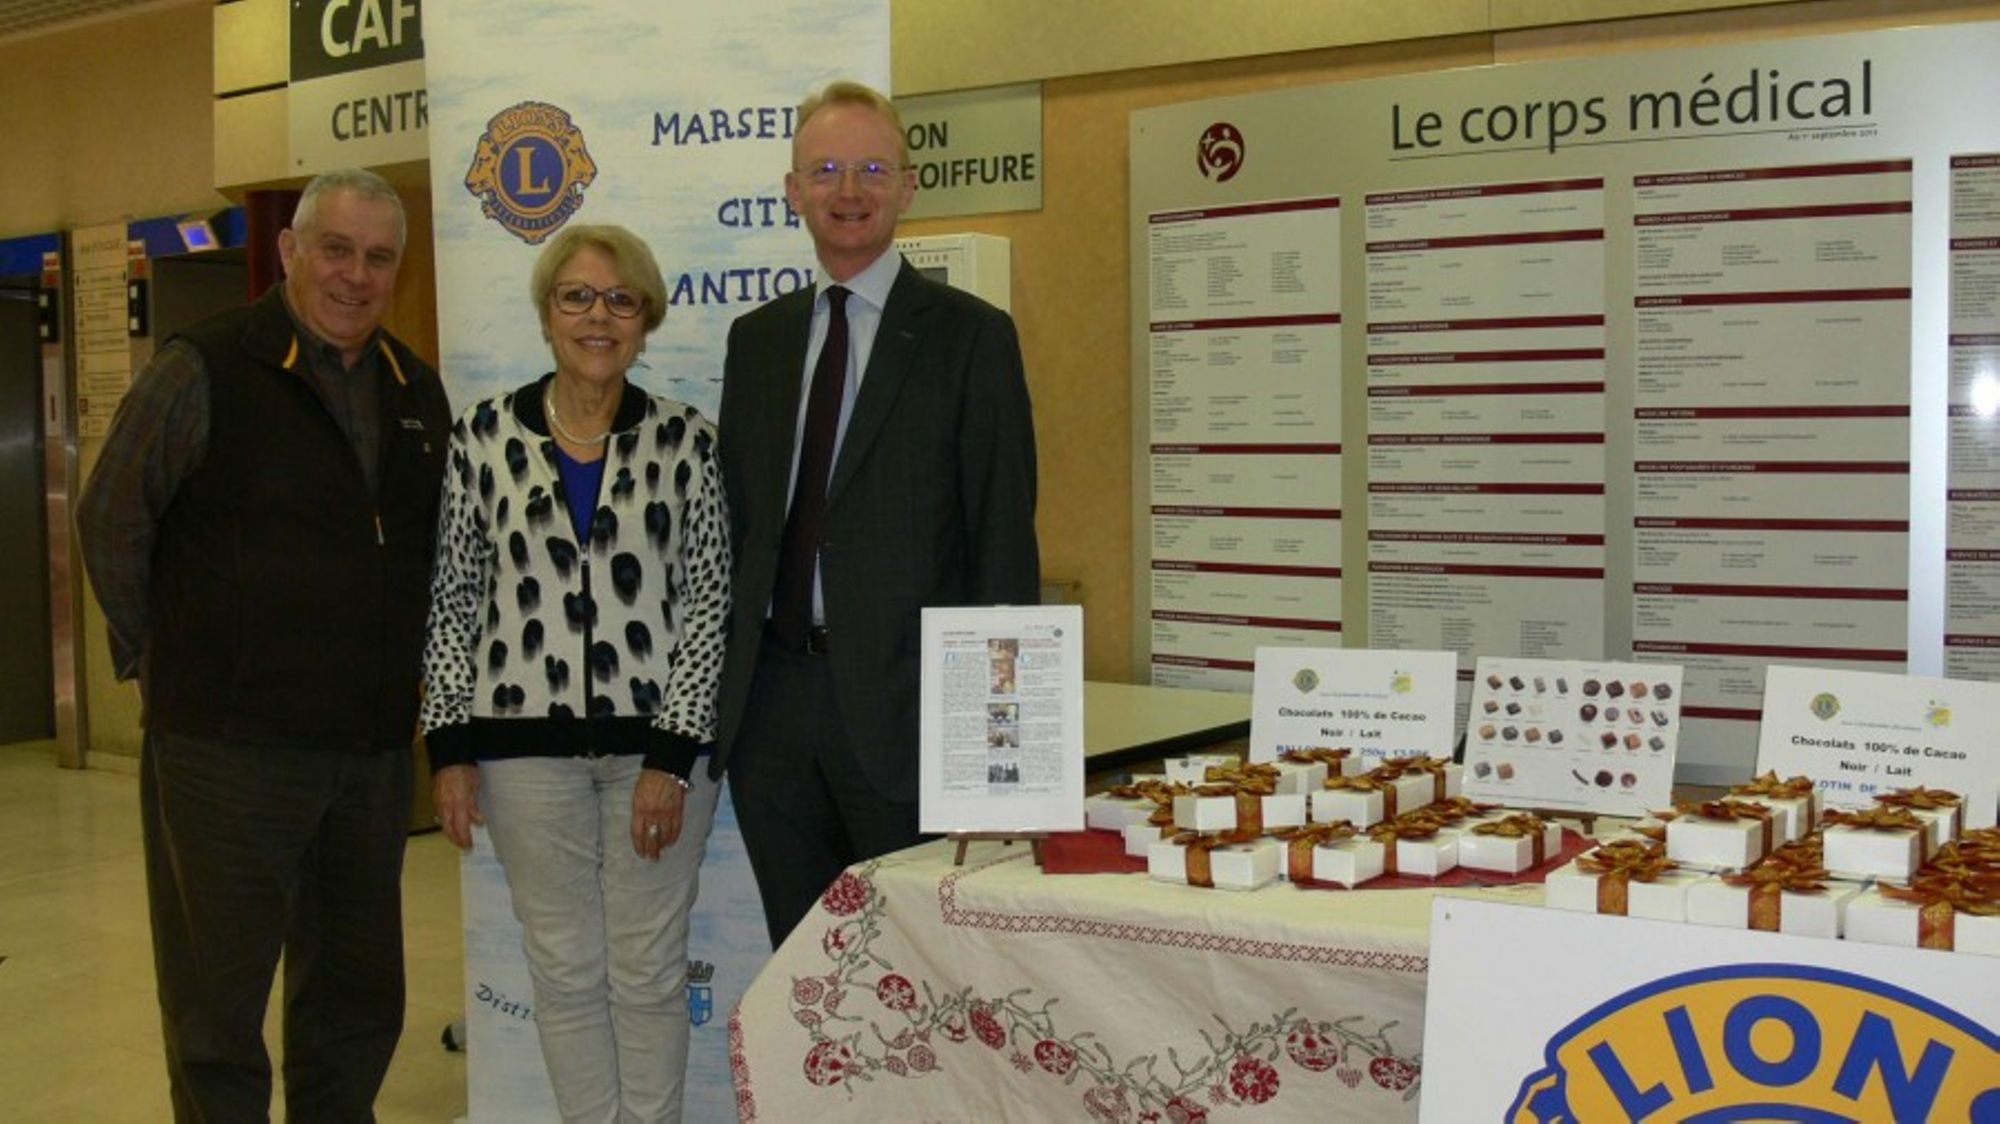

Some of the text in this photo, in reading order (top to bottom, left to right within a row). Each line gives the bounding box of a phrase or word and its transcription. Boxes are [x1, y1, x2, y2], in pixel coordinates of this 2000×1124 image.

[321, 0, 415, 57] CAF
[332, 89, 429, 141] CENTR
[1391, 59, 1873, 154] Le corps médical
[651, 106, 800, 146] MARSEI
[907, 121, 948, 150] ON
[514, 146, 551, 194] L
[911, 154, 1035, 190] OIFFURE
[1278, 706, 1426, 722] Chocolats 100% de Cacao
[1320, 728, 1344, 738] Noir
[1360, 728, 1382, 739] Lait
[1791, 735, 1967, 760] Chocolats 100% de Cacao
[1839, 760, 1868, 773] Noir
[1886, 764, 1912, 777] Lait
[1587, 994, 2000, 1124] LION
